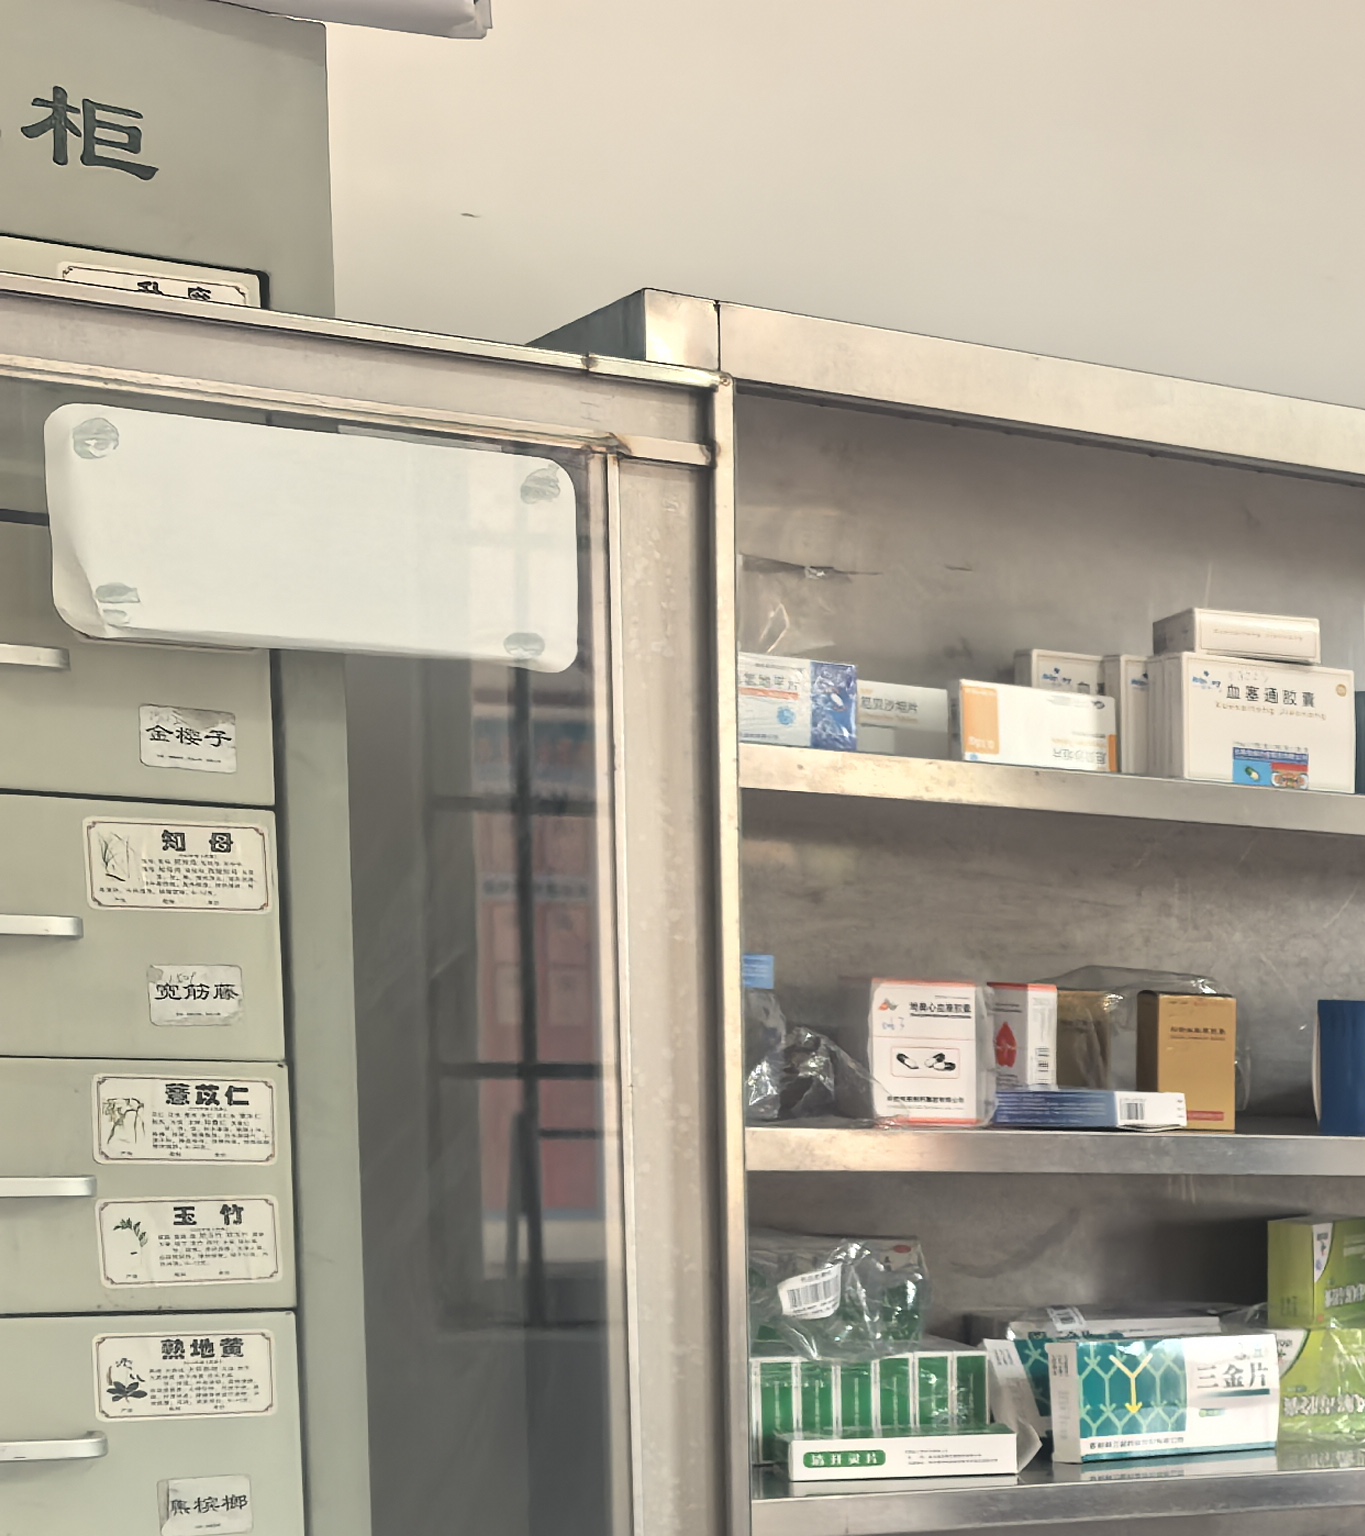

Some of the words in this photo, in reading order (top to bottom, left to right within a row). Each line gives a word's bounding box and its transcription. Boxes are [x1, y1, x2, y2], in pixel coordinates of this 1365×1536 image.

[20, 86, 158, 181] 柜
[1226, 683, 1316, 708] 血塞通胶囊
[146, 724, 232, 748] 金樱子
[162, 829, 233, 853] 知母
[155, 983, 239, 1001] 宽筋藤
[165, 1083, 250, 1106] 薏苡仁
[173, 1204, 244, 1226] 玉竹
[160, 1337, 245, 1360] 熟地黄
[1197, 1361, 1269, 1390] 三金片
